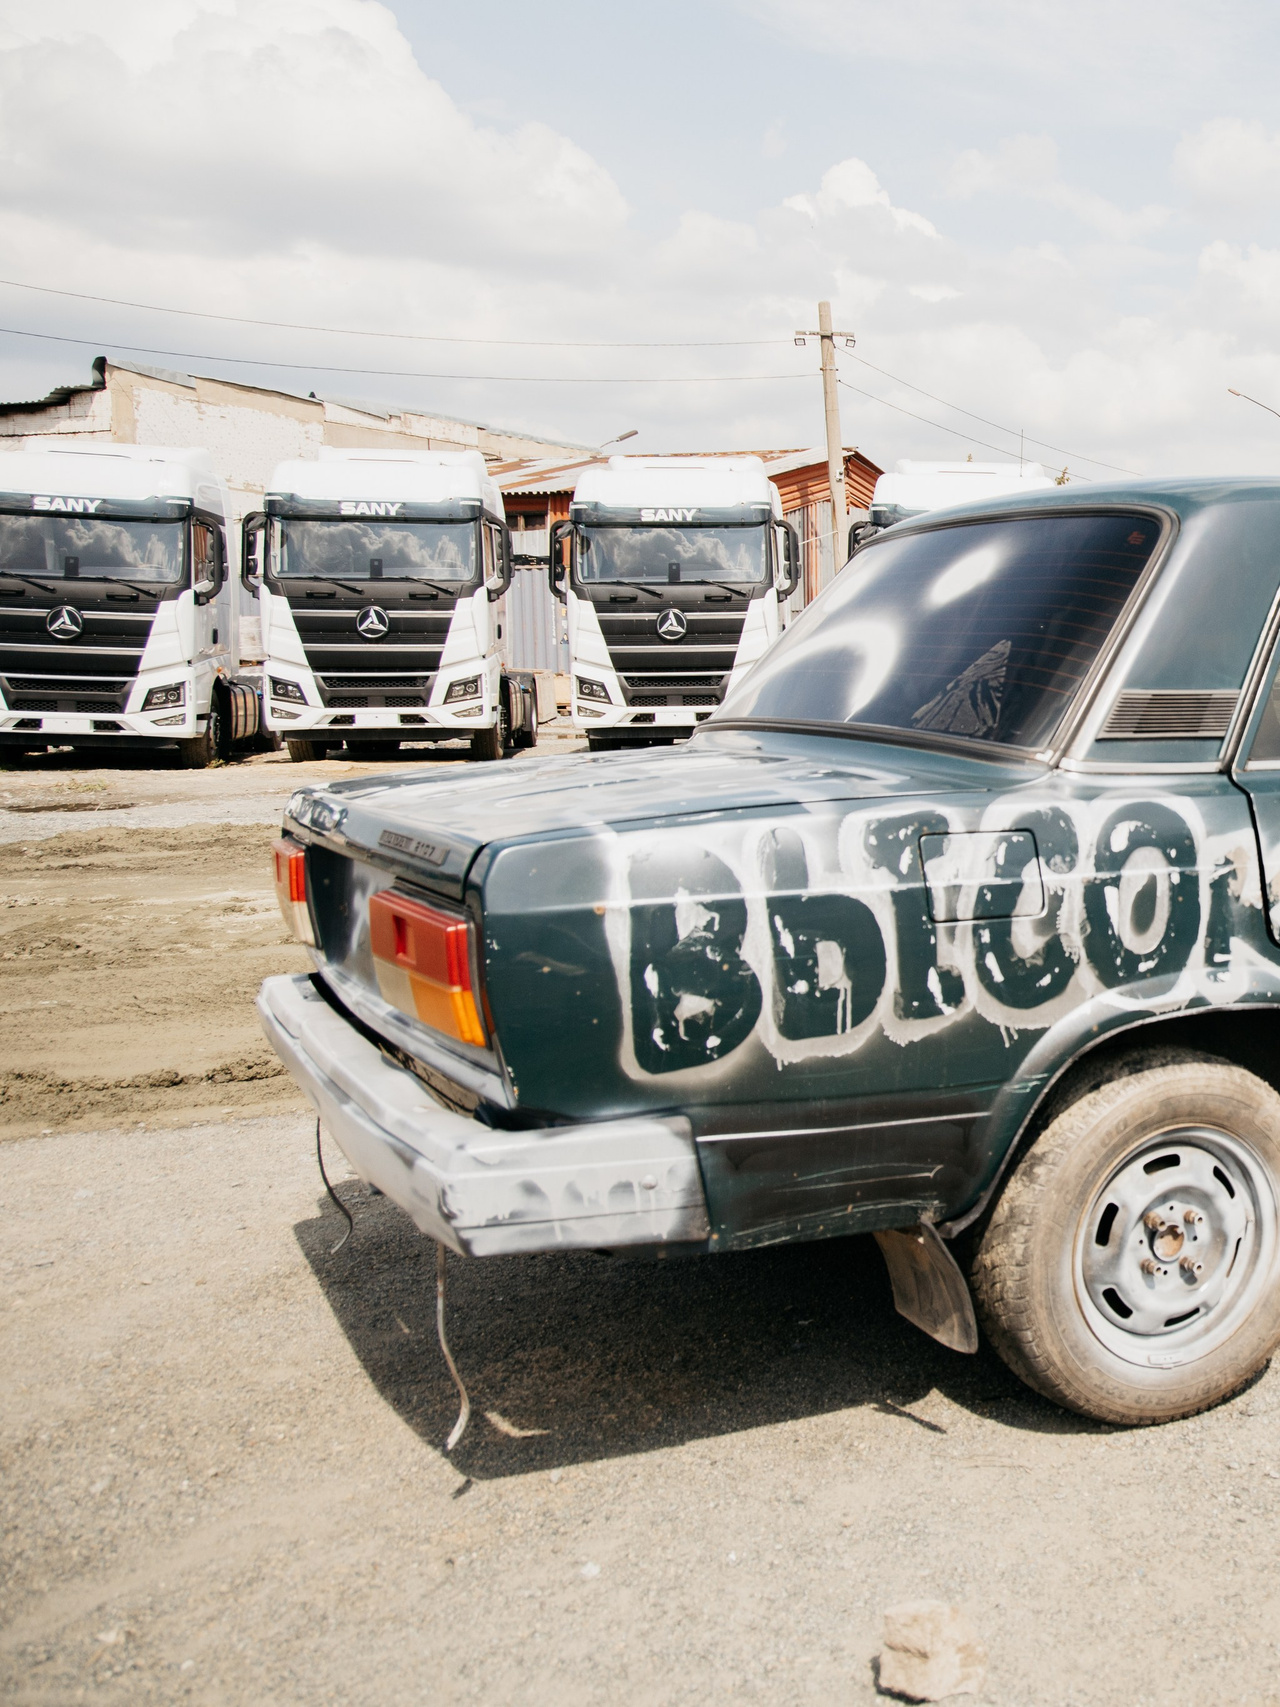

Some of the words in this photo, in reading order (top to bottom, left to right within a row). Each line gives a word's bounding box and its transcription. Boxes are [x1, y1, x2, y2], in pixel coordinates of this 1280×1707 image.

[33, 495, 102, 513] SANY
[340, 501, 402, 516] SANY
[640, 508, 697, 522] SANY
